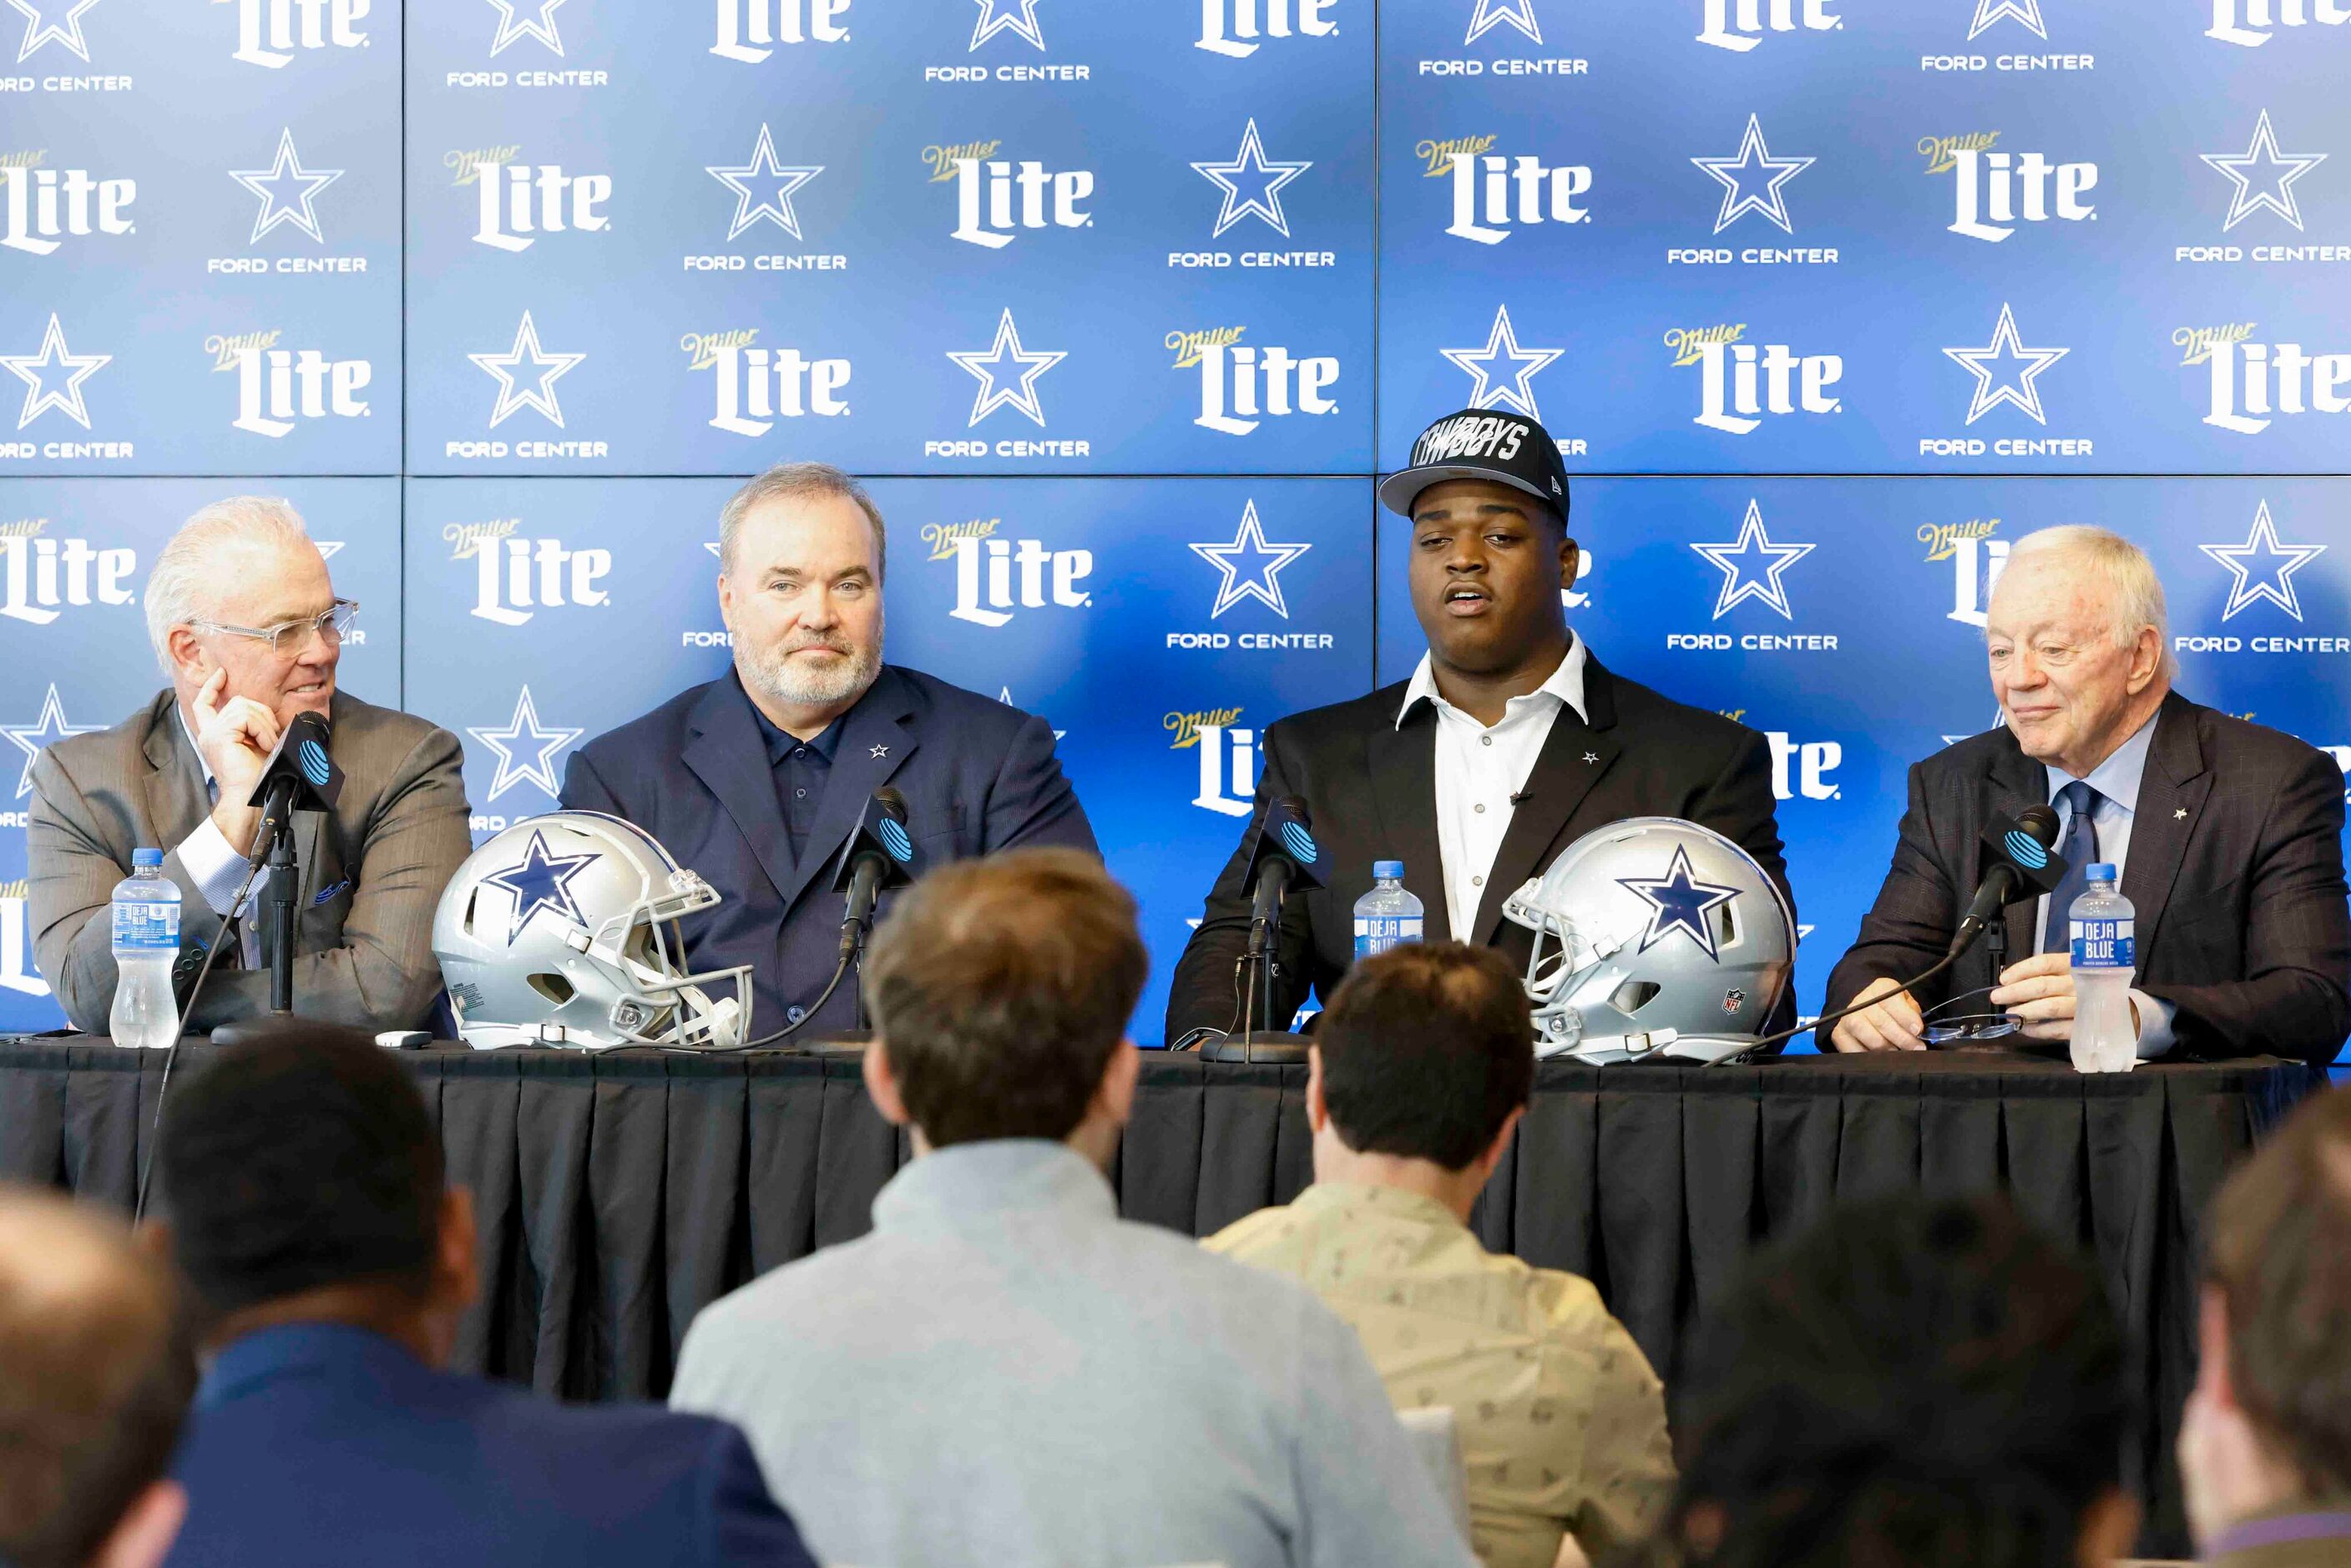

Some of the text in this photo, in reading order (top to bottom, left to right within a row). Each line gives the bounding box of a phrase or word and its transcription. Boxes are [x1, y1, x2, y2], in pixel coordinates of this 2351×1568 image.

[1419, 59, 1588, 74] FORD CENTER
[1922, 54, 2094, 70] FORD CENTER
[447, 71, 608, 87] FORD CENTER
[926, 66, 1090, 81] FORD CENTER
[43, 76, 132, 91] CENTER
[922, 139, 1001, 182] Miller
[1415, 134, 1497, 177] Miller
[1917, 130, 2000, 174] Miller
[0, 149, 45, 174] iller
[442, 144, 520, 186] Miller
[1169, 252, 1335, 267] FORD CENTER
[1668, 249, 1838, 263] FORD CENTER
[2176, 246, 2351, 261] FORD CENTER
[208, 258, 367, 273] FORD CENTER
[684, 255, 846, 271] FORD CENTER
[205, 330, 281, 372] Miller
[680, 328, 759, 371] Miller
[1164, 326, 1245, 368] Miller
[1664, 323, 1747, 367] Miller
[2172, 322, 2255, 366] Miller
[43, 443, 133, 458] CENTER
[447, 442, 608, 458] FORD CENTER
[925, 441, 1090, 457] FORD CENTER
[1413, 417, 1529, 467] COWBOYS
[1920, 439, 2092, 455] FORD CENTER
[0, 518, 45, 544] iller
[441, 518, 519, 559] Miller
[921, 518, 1000, 560] Miller
[1917, 519, 2001, 565] Miller
[1946, 537, 2010, 628] Li
[1167, 634, 1333, 648] FORD CENTER
[1667, 635, 1838, 650] FORD CENTER
[2175, 637, 2350, 652] FORD CENTER
[1163, 707, 1244, 749] Miller
[1191, 726, 1266, 817] Li
[1764, 731, 1842, 800] te
[2086, 923, 2114, 940] DEJA
[2086, 941, 2115, 959] BLUE
[1724, 999, 1742, 1011] NFL
